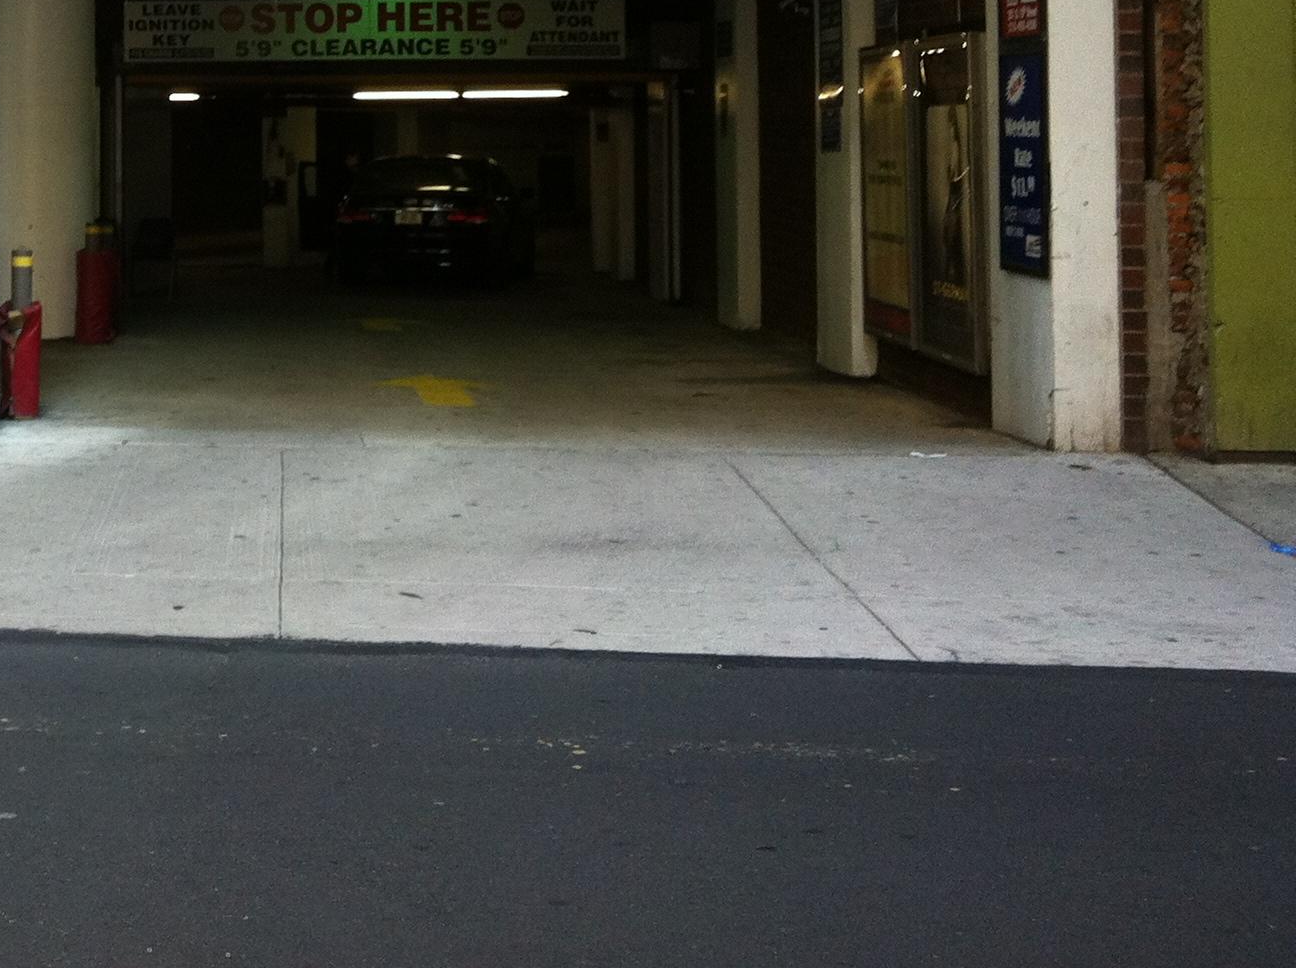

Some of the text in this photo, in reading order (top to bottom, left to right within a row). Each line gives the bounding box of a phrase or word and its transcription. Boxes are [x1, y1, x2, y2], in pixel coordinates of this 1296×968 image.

[142, 3, 201, 17] LEAVE
[551, 0, 598, 13] WAIT
[251, 2, 363, 34] STOP
[377, 1, 493, 32] HERE
[556, 15, 594, 28] FOR
[129, 18, 214, 32] IGNITION
[152, 34, 191, 46] KEY
[530, 30, 621, 43] ATTENDANT
[291, 38, 450, 57] CLEARANCE
